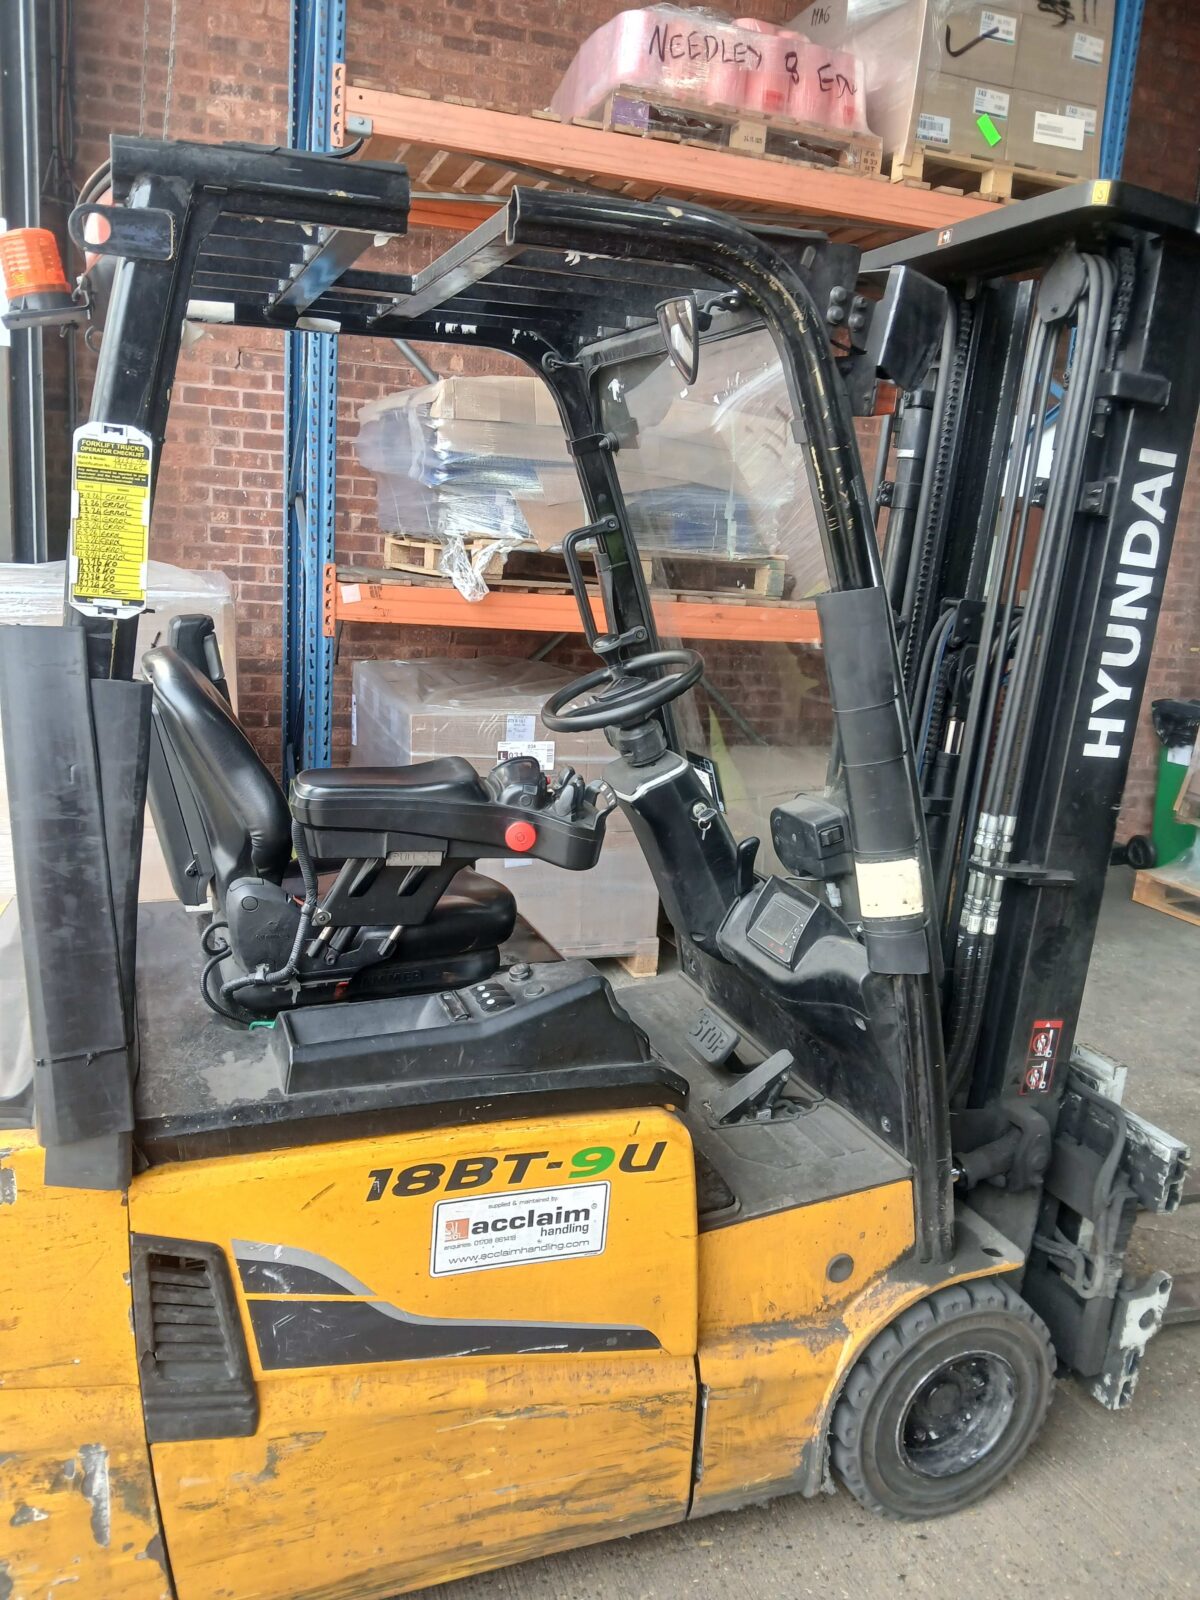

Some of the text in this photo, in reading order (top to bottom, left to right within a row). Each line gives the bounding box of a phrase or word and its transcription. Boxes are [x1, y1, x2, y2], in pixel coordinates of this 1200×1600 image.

[80, 446, 145, 458] OPERATOR CHECKLIST
[81, 439, 145, 453] FORKLIFT TRUCKS
[1082, 447, 1178, 759] HYUNDAI
[366, 1141, 667, 1201] 18BT-9U
[488, 1200, 511, 1209] supplied
[519, 1196, 550, 1205] maintained
[540, 1223, 589, 1238] handling
[448, 1239, 590, 1265] www.acclaimhandling.com
